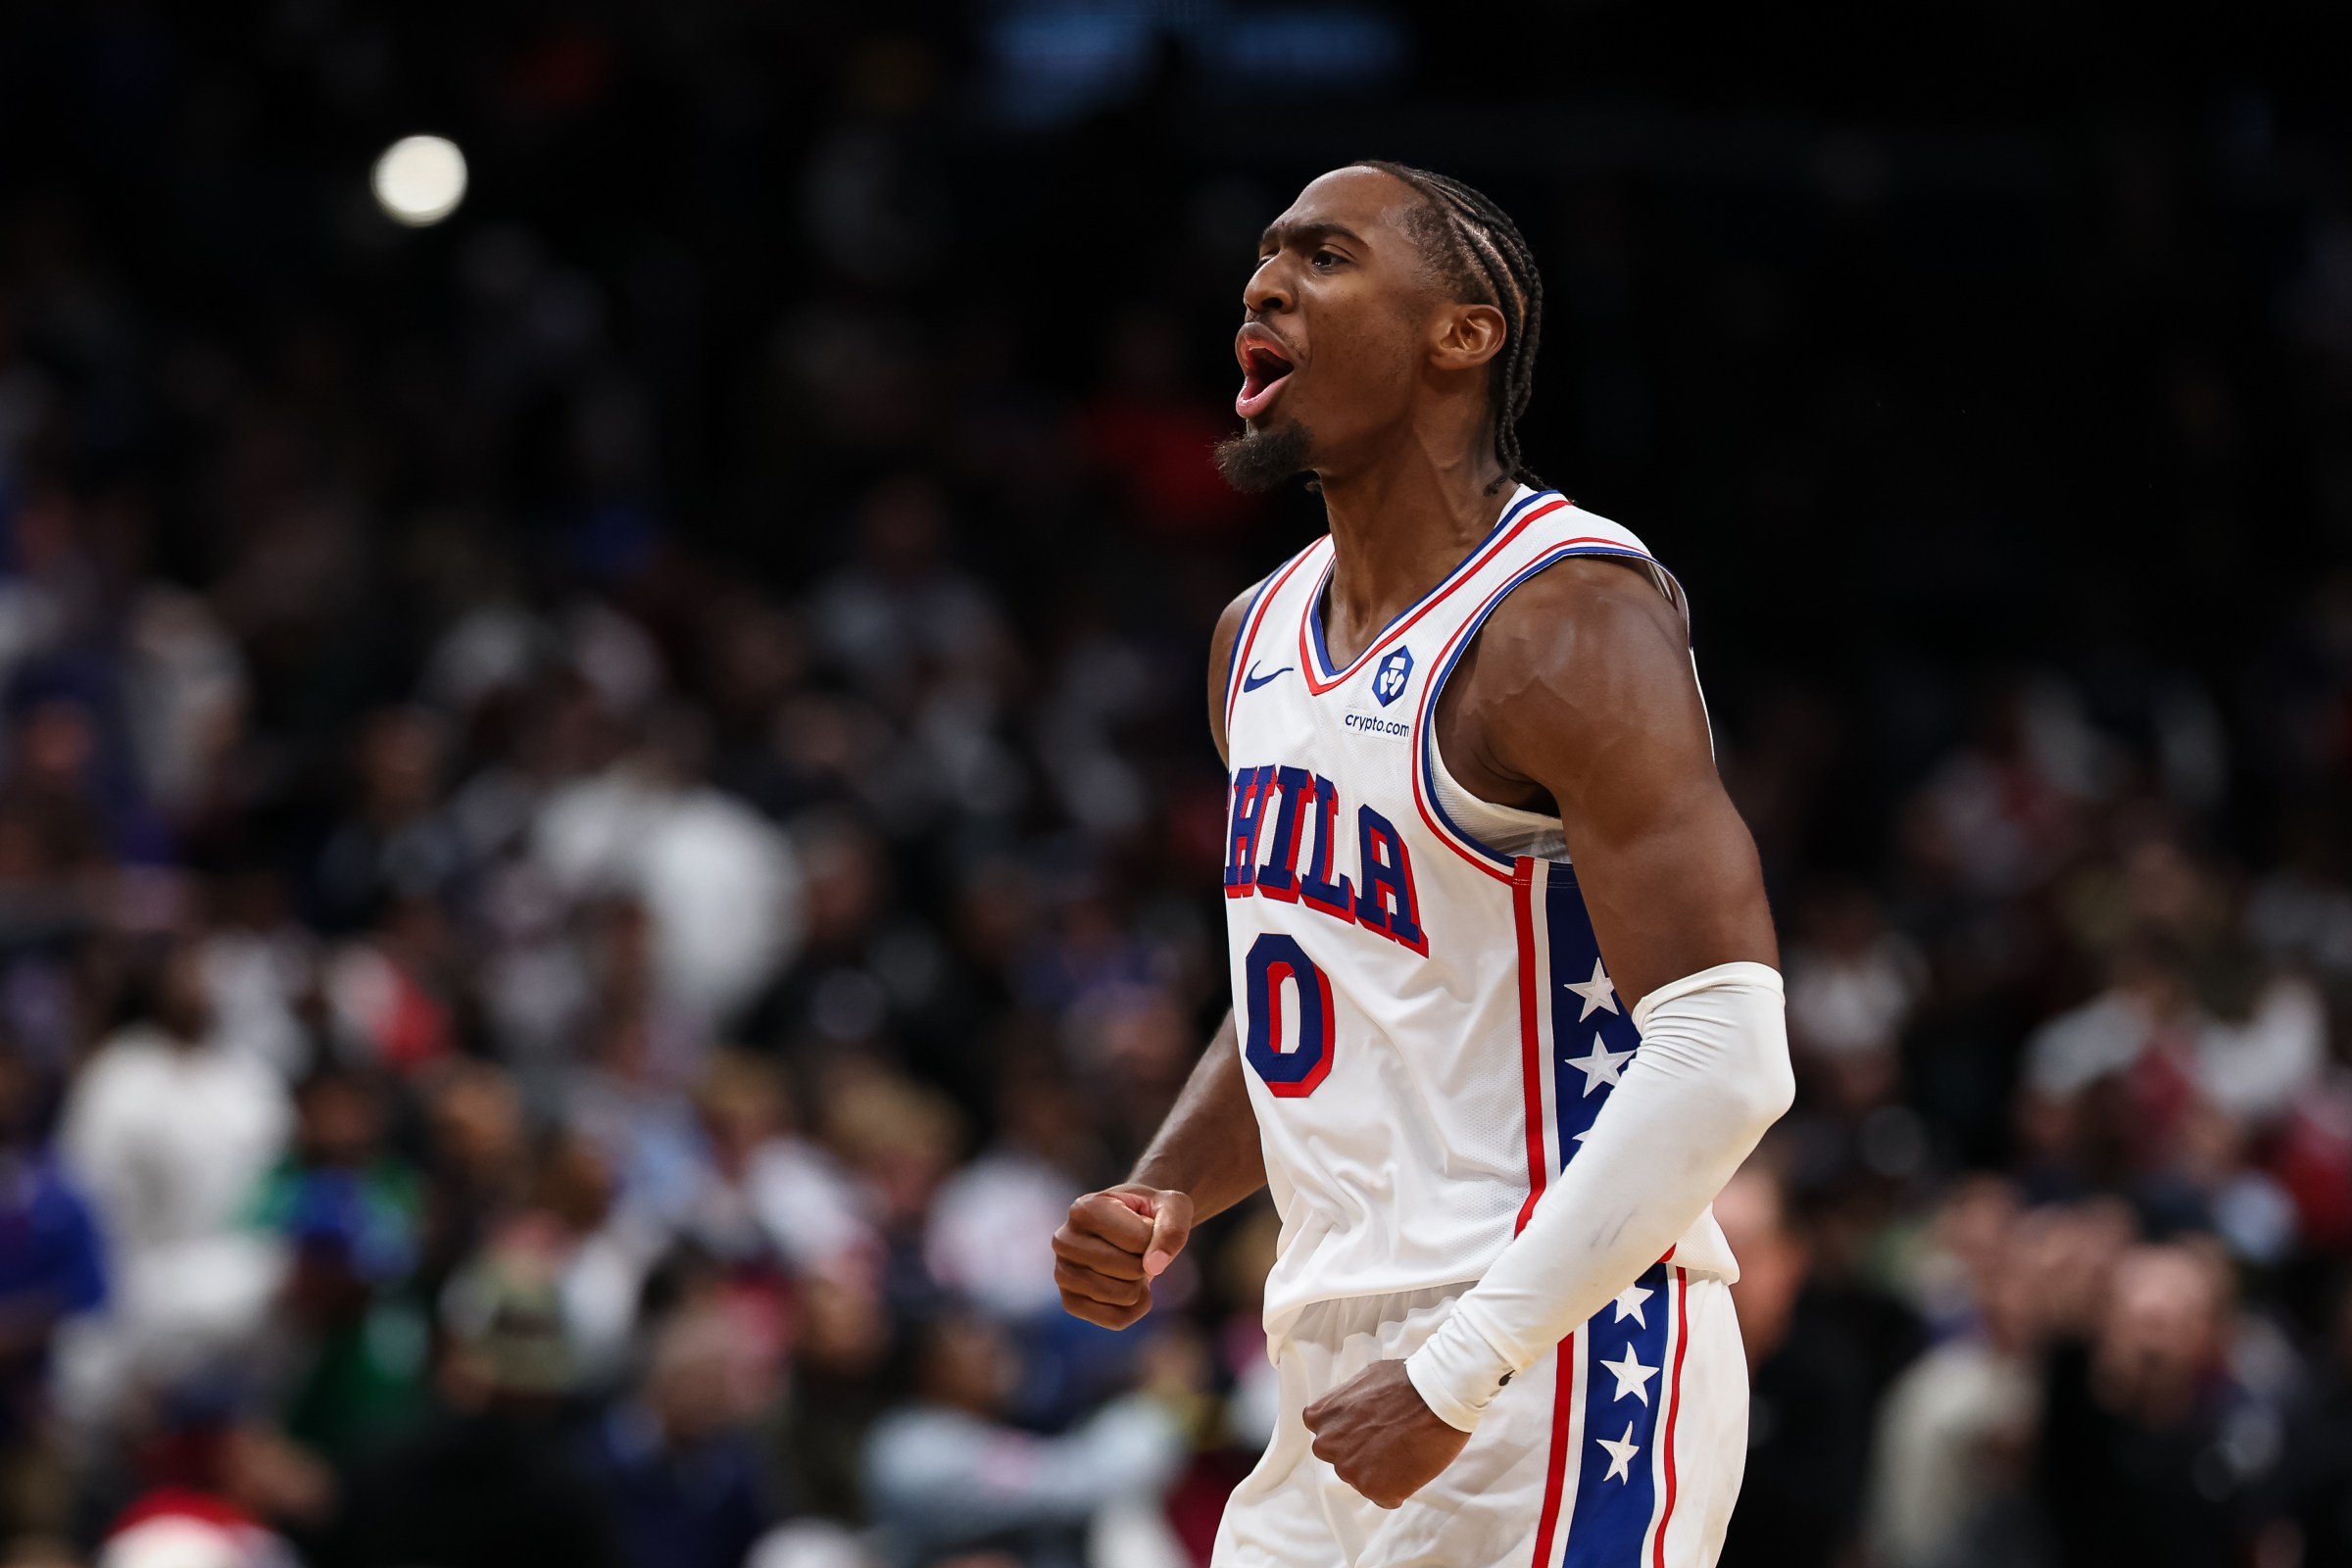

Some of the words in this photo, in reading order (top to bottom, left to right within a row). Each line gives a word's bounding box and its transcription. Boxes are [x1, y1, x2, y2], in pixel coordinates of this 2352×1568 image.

[1345, 713, 1410, 738] crypto.com
[1224, 763, 1429, 958] HILA
[1246, 932, 1336, 1099] 0
